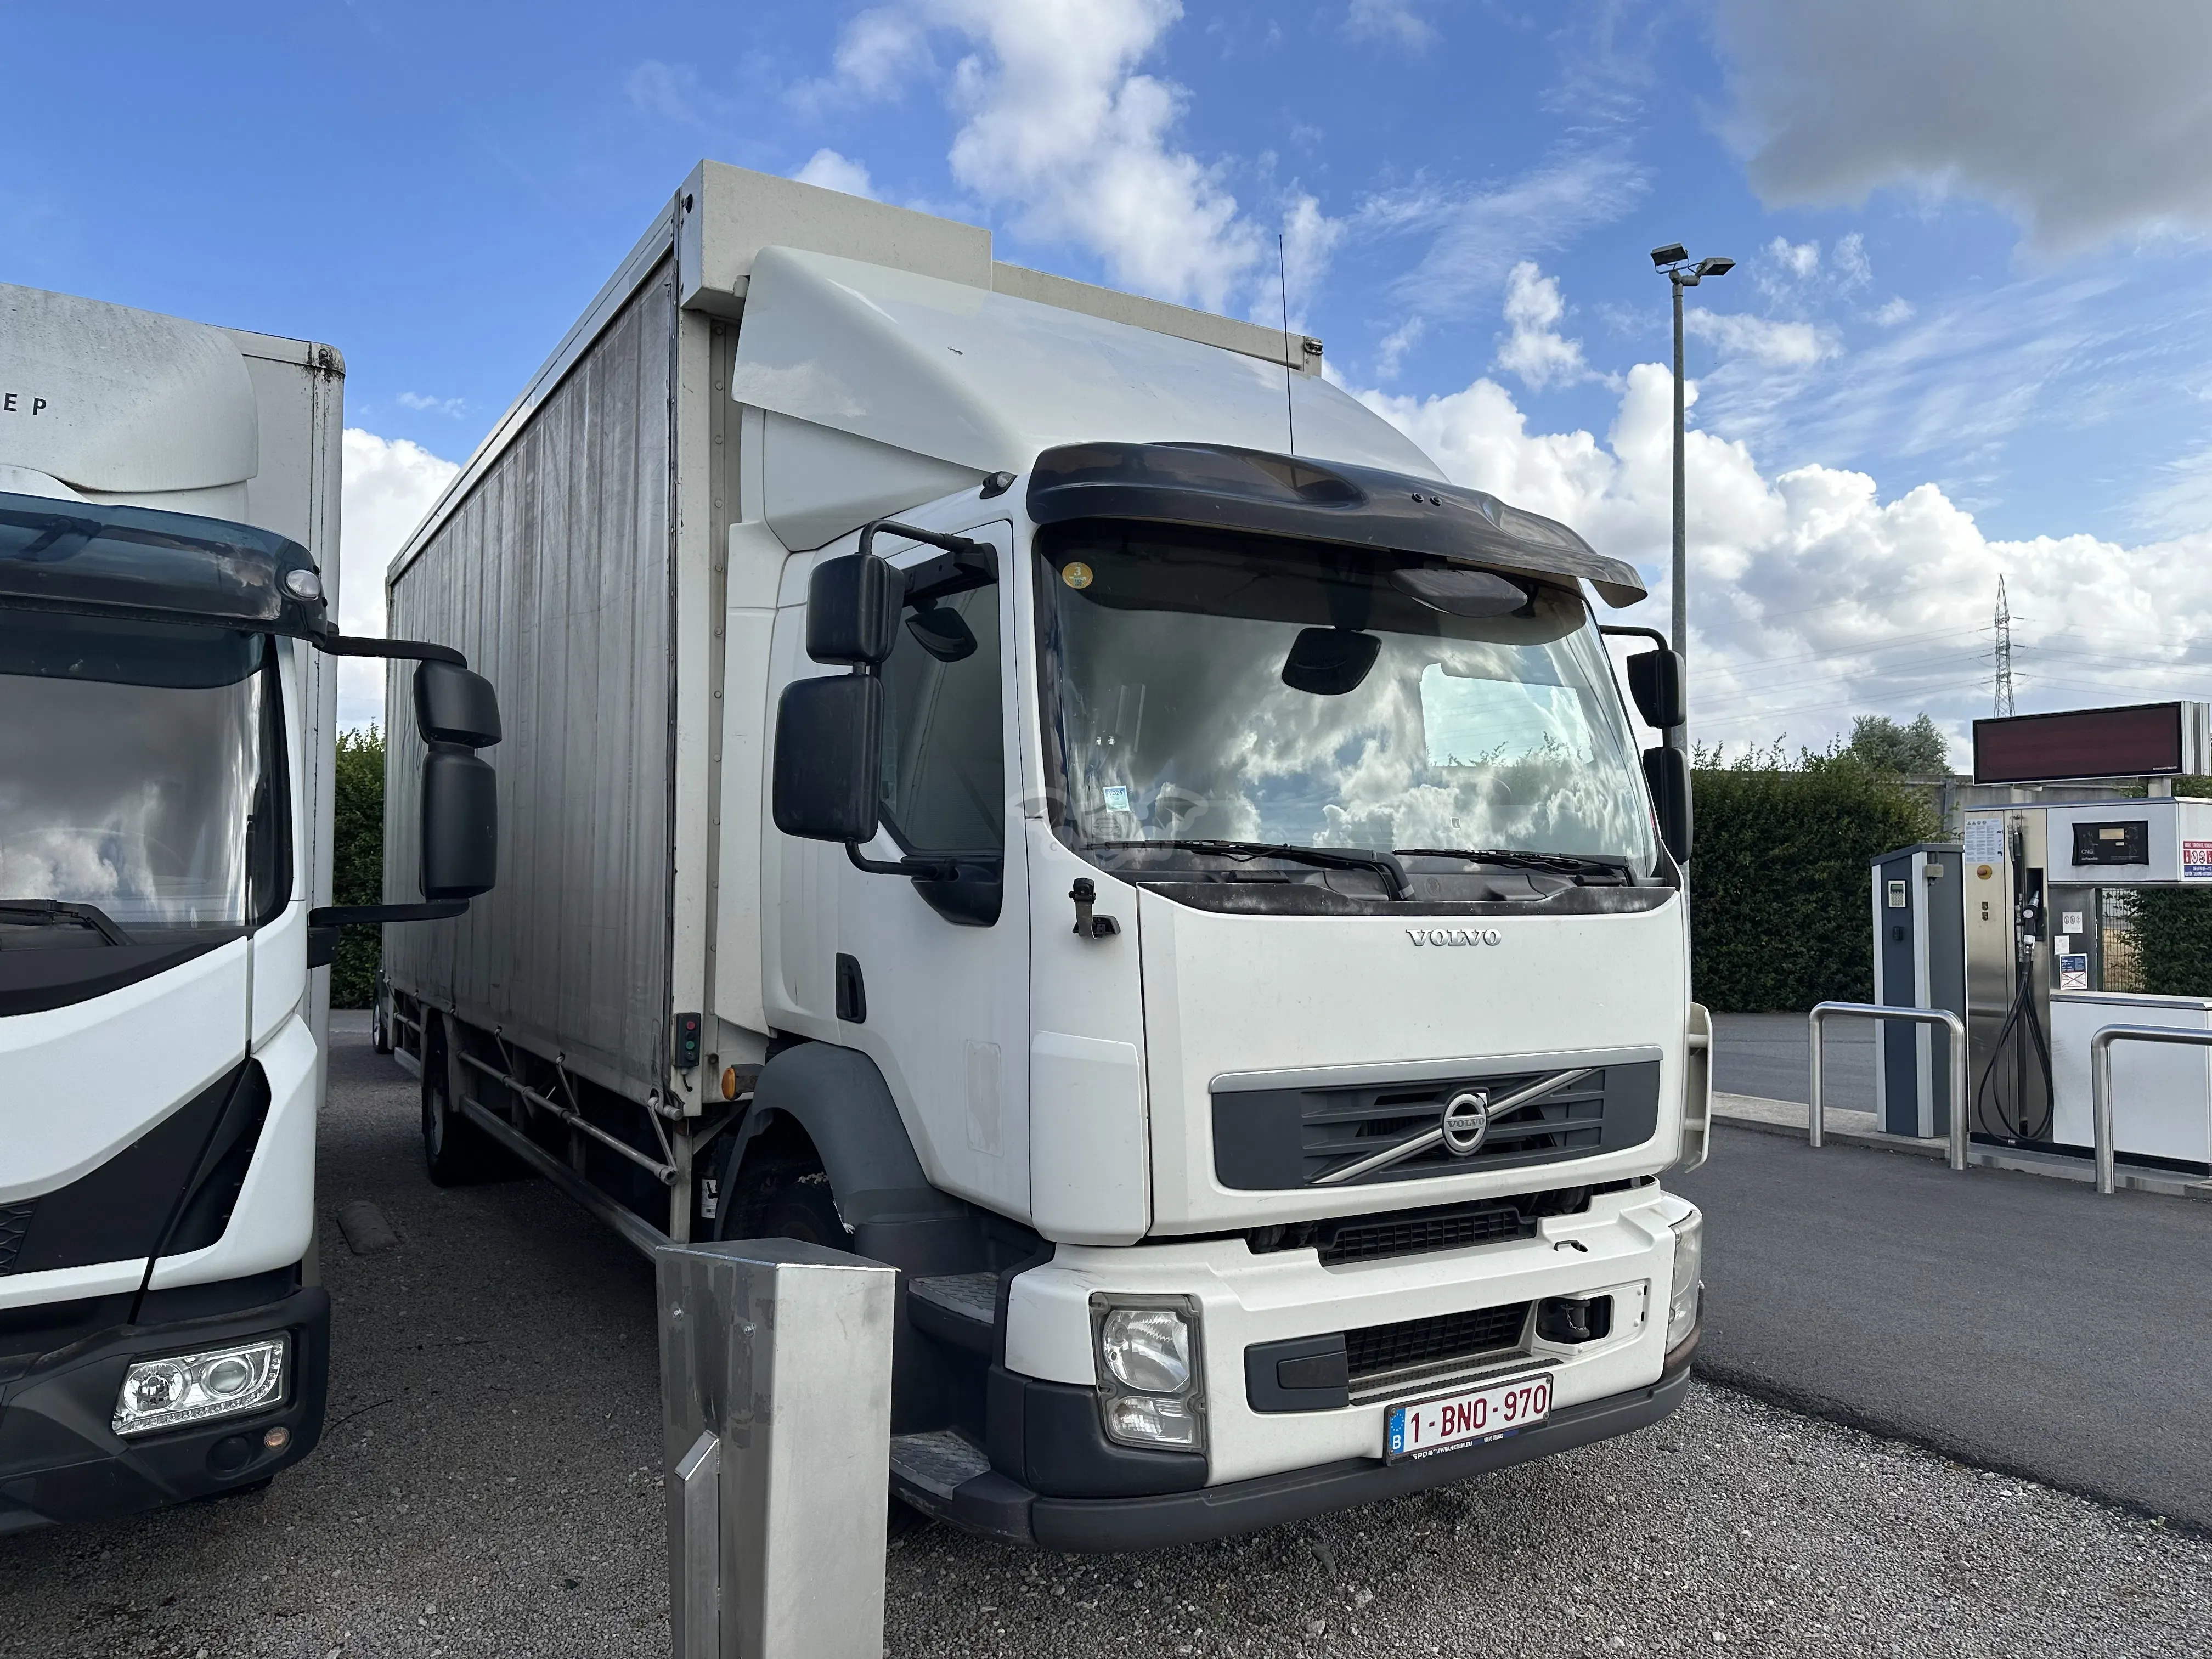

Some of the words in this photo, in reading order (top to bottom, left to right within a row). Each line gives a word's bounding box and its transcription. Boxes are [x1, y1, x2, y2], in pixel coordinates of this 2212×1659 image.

[1074, 567, 1081, 576] 3
[1406, 929, 1502, 946] VOLVO
[1446, 1118, 1485, 1128] VOLVO
[1392, 1435, 1401, 1450] B
